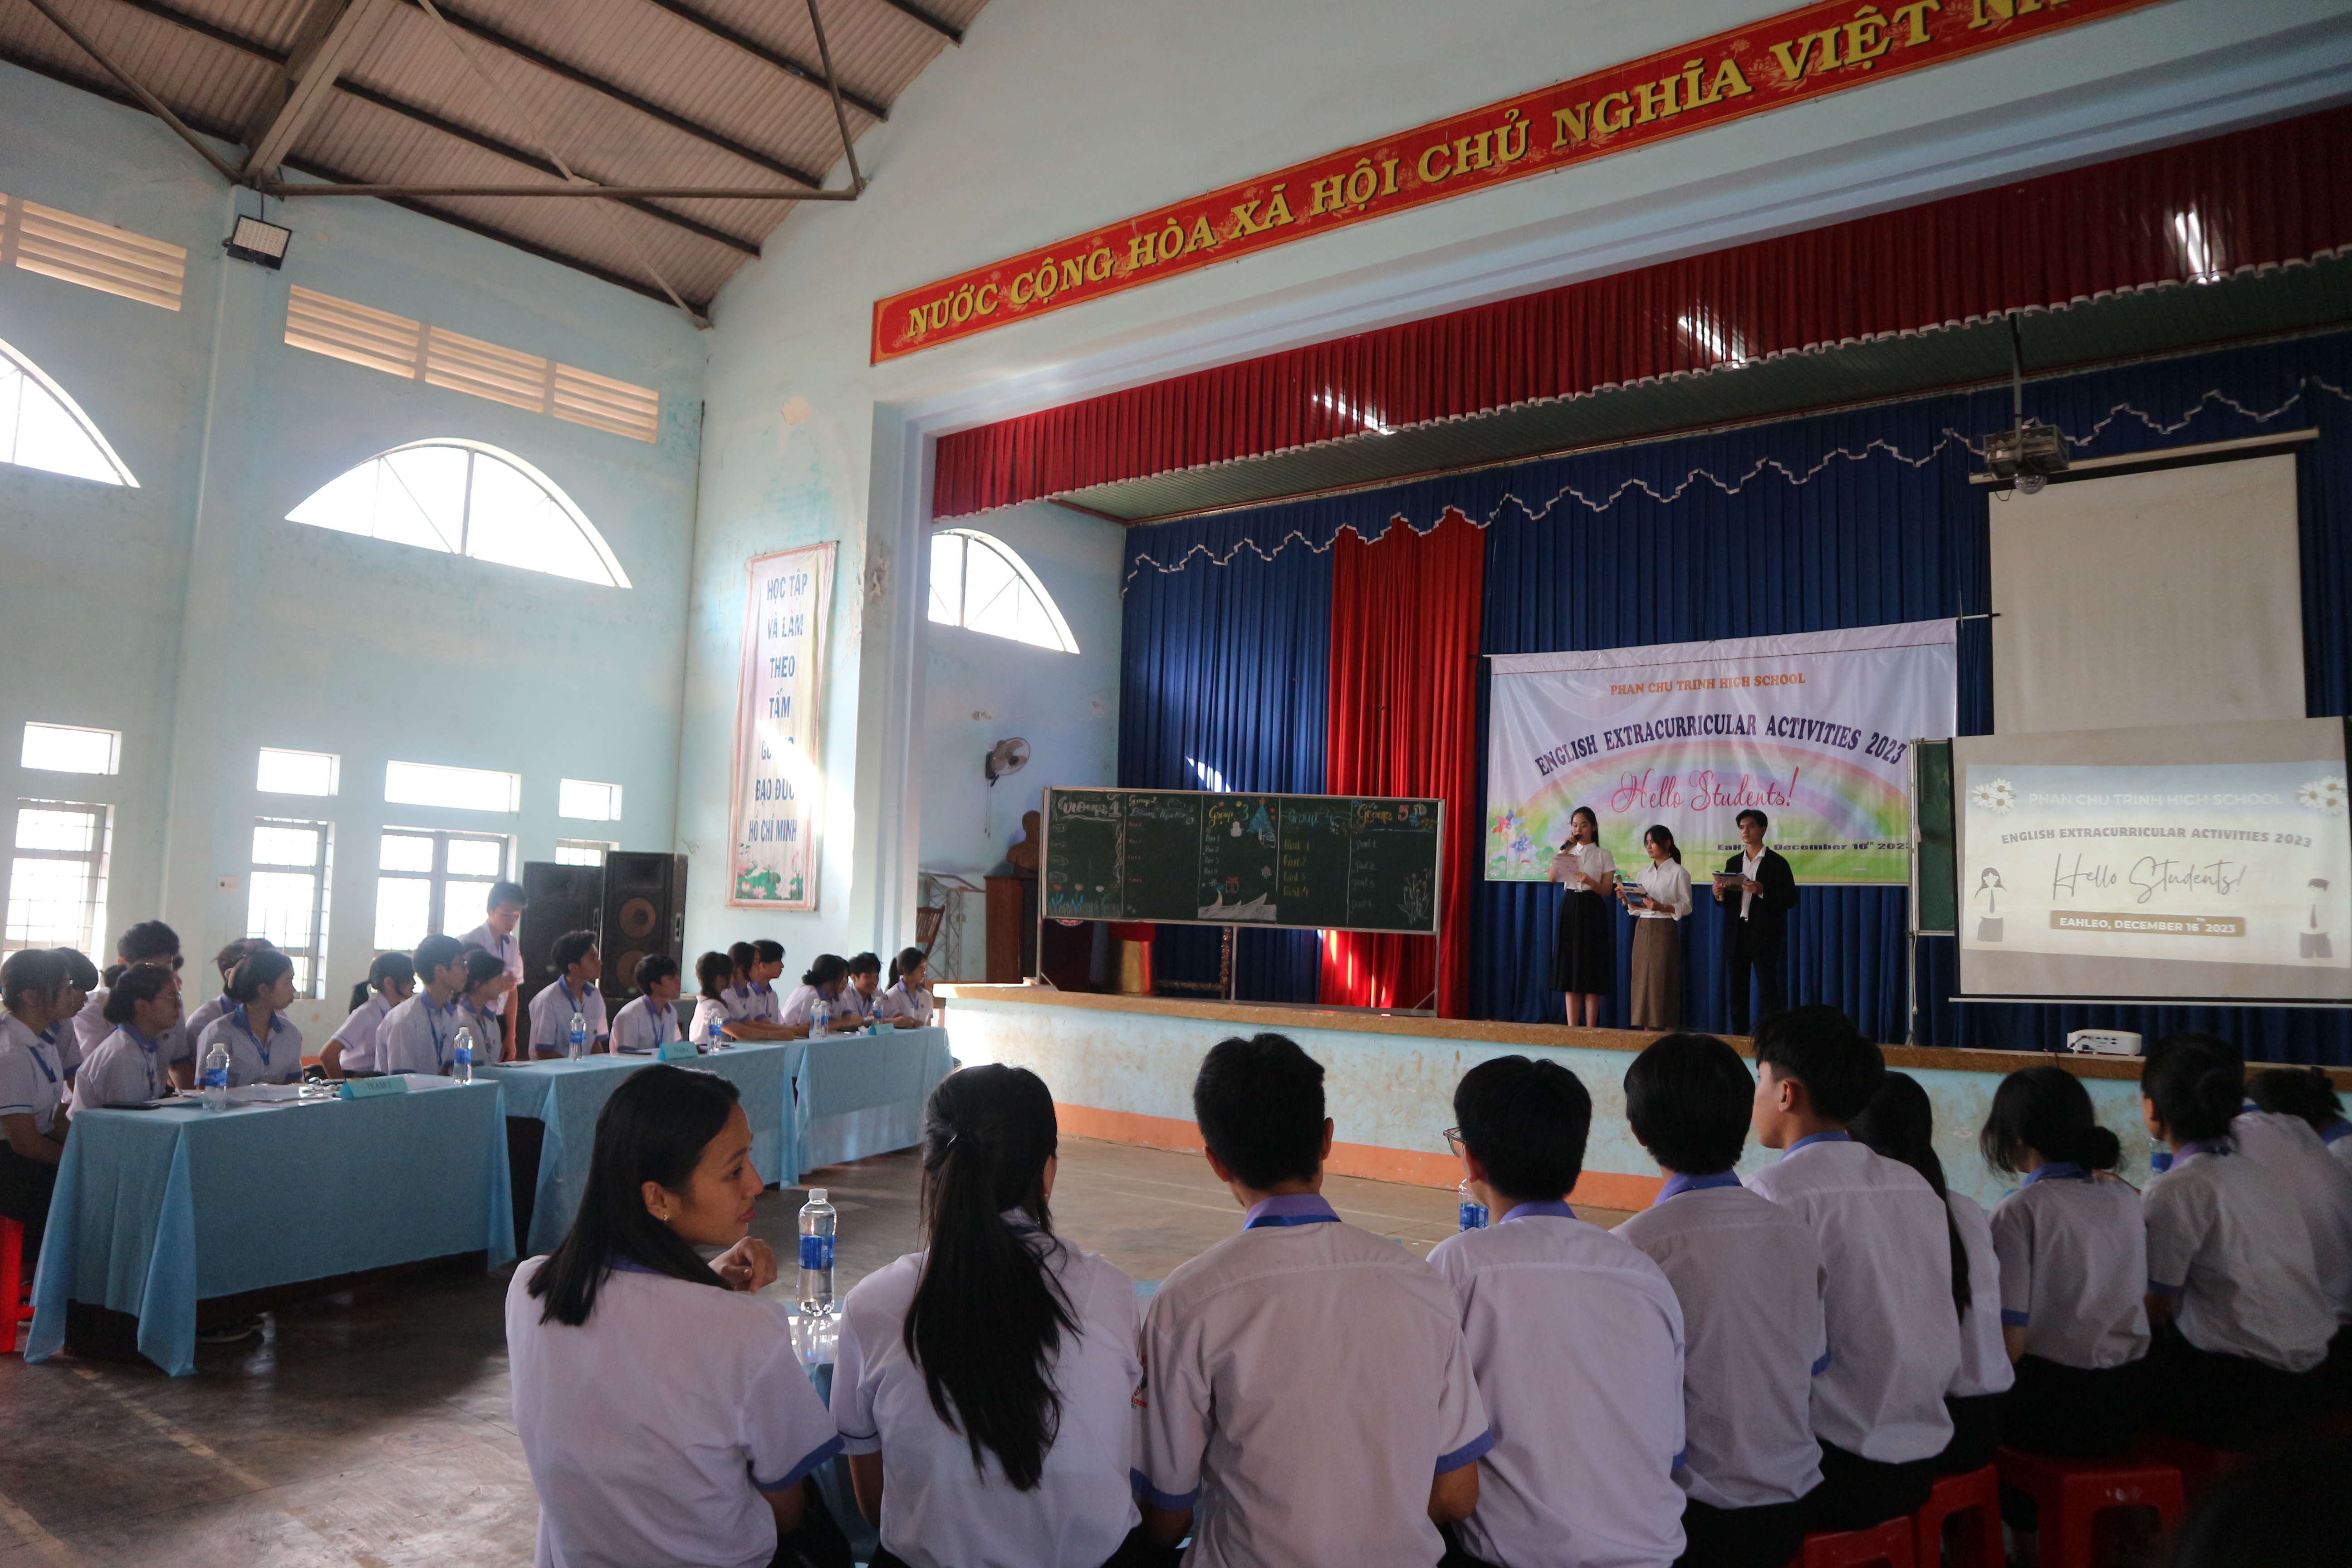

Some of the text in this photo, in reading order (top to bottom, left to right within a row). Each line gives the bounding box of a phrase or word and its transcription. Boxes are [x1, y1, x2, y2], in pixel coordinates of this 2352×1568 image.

[908, 283, 998, 337] NƯỚC
[1010, 247, 1115, 304] CỘNG
[1127, 217, 1219, 271] HÒA
[1228, 183, 1295, 240] XÃ
[1309, 158, 1401, 216] HỘI
[1418, 108, 1532, 183] CHỦ
[1552, 58, 1754, 148] NGHĨA
[1769, 0, 1944, 80] VIỆT
[767, 568, 808, 604] HỌC TẬP
[768, 609, 804, 640] VÀ LÀM
[770, 655, 795, 679] THEO
[1611, 673, 1806, 695] PHAN CHU TRINH HIGH SCHOOL
[769, 687, 790, 719] TẤM
[1535, 714, 1906, 776] ENGLISH EXTRACURRICULAR ACTIVITIES 2023
[755, 778, 771, 805] ĐẠO
[1611, 766, 1799, 813] Hello Students!
[2029, 793, 2283, 805] PHAN CHU TRINH HIGH SCHOOL
[761, 813, 774, 842] CHÍ
[775, 819, 797, 842] MINH
[1209, 804, 1249, 827] Group 3
[1288, 808, 1318, 826] Group
[1356, 804, 1409, 825] Group 5
[2001, 826, 2312, 848] ENGLISH EXTRACURRICULAR ACTIVITIES 2023
[2053, 853, 2246, 904] Hello Students!
[2059, 917, 2112, 930] EAHLEO,
[2114, 919, 2183, 931] DECEMBER
[2205, 924, 2236, 933] 2023
